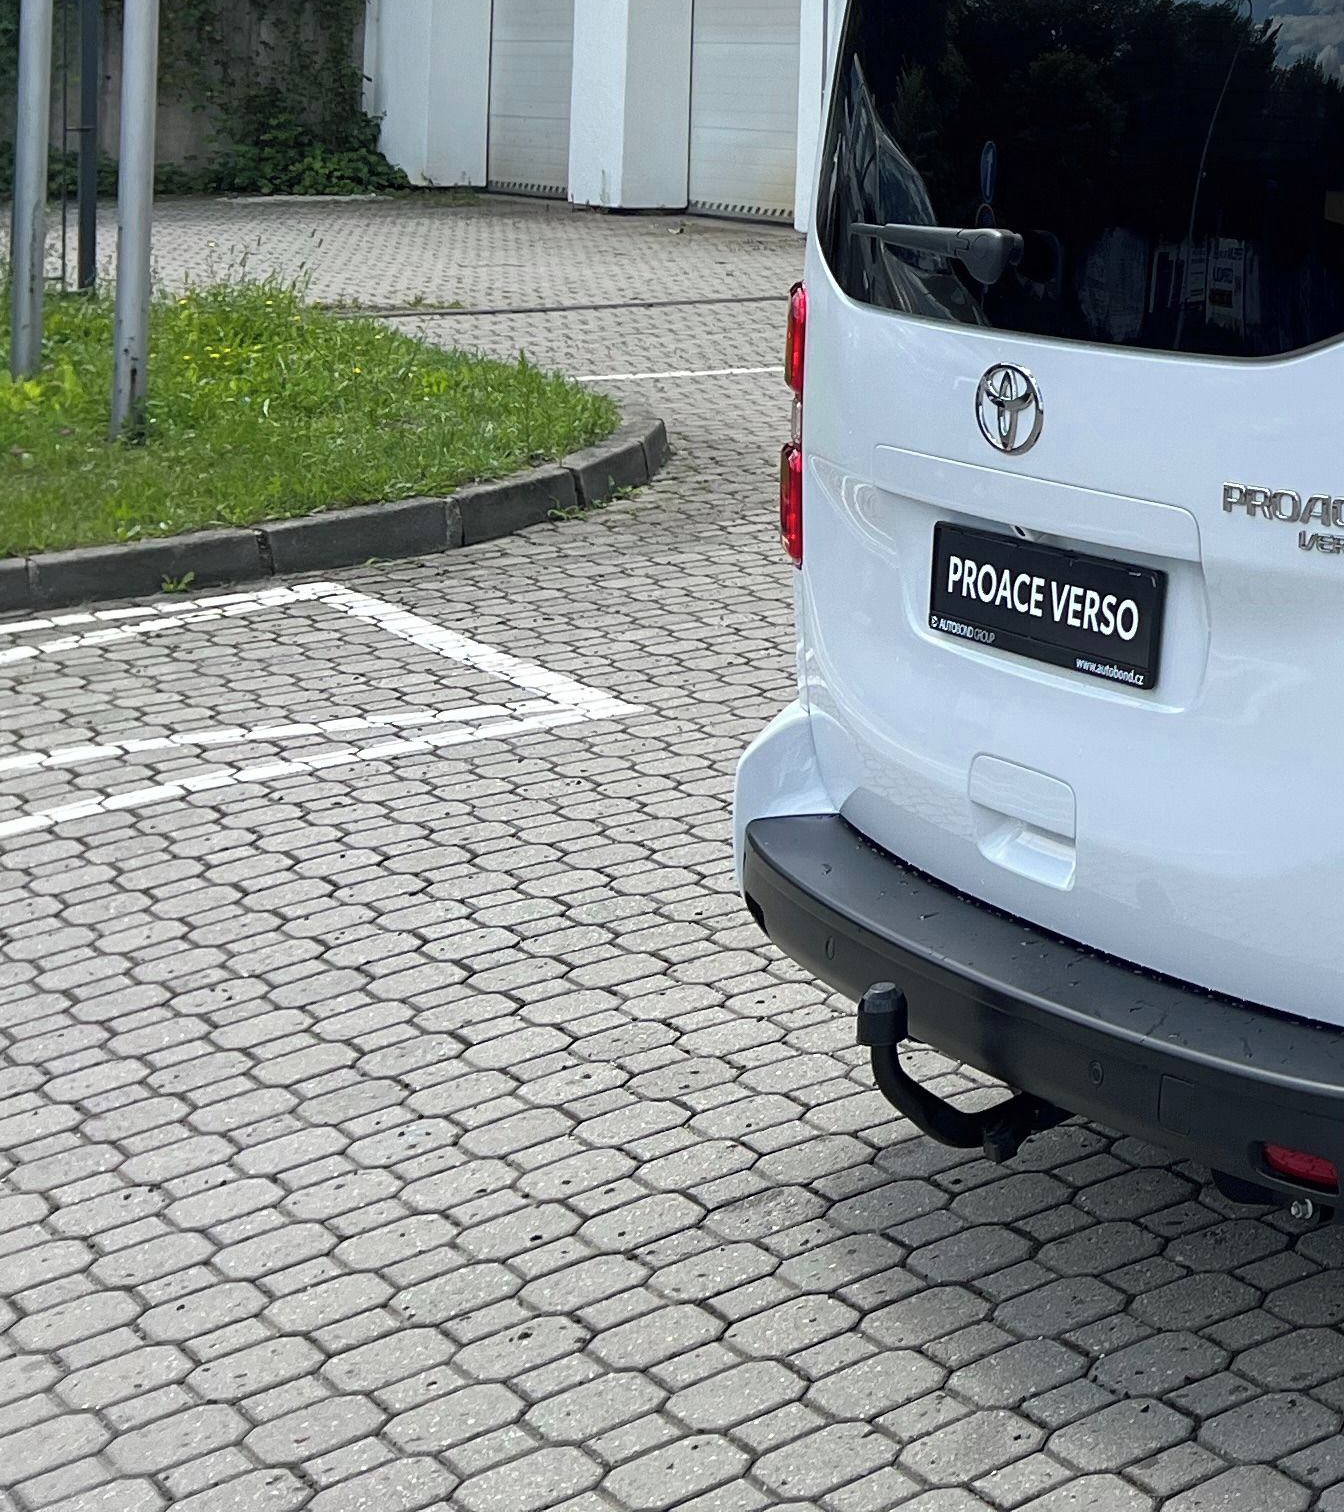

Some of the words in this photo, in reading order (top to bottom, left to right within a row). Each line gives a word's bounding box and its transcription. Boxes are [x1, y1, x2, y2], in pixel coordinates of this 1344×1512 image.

[947, 555, 1046, 618] PROACE
[1050, 581, 1140, 641] VERSO
[938, 618, 974, 639] AUTOBOND
[974, 628, 996, 645] GROUP
[1076, 657, 1144, 686] www.autobond.cz
